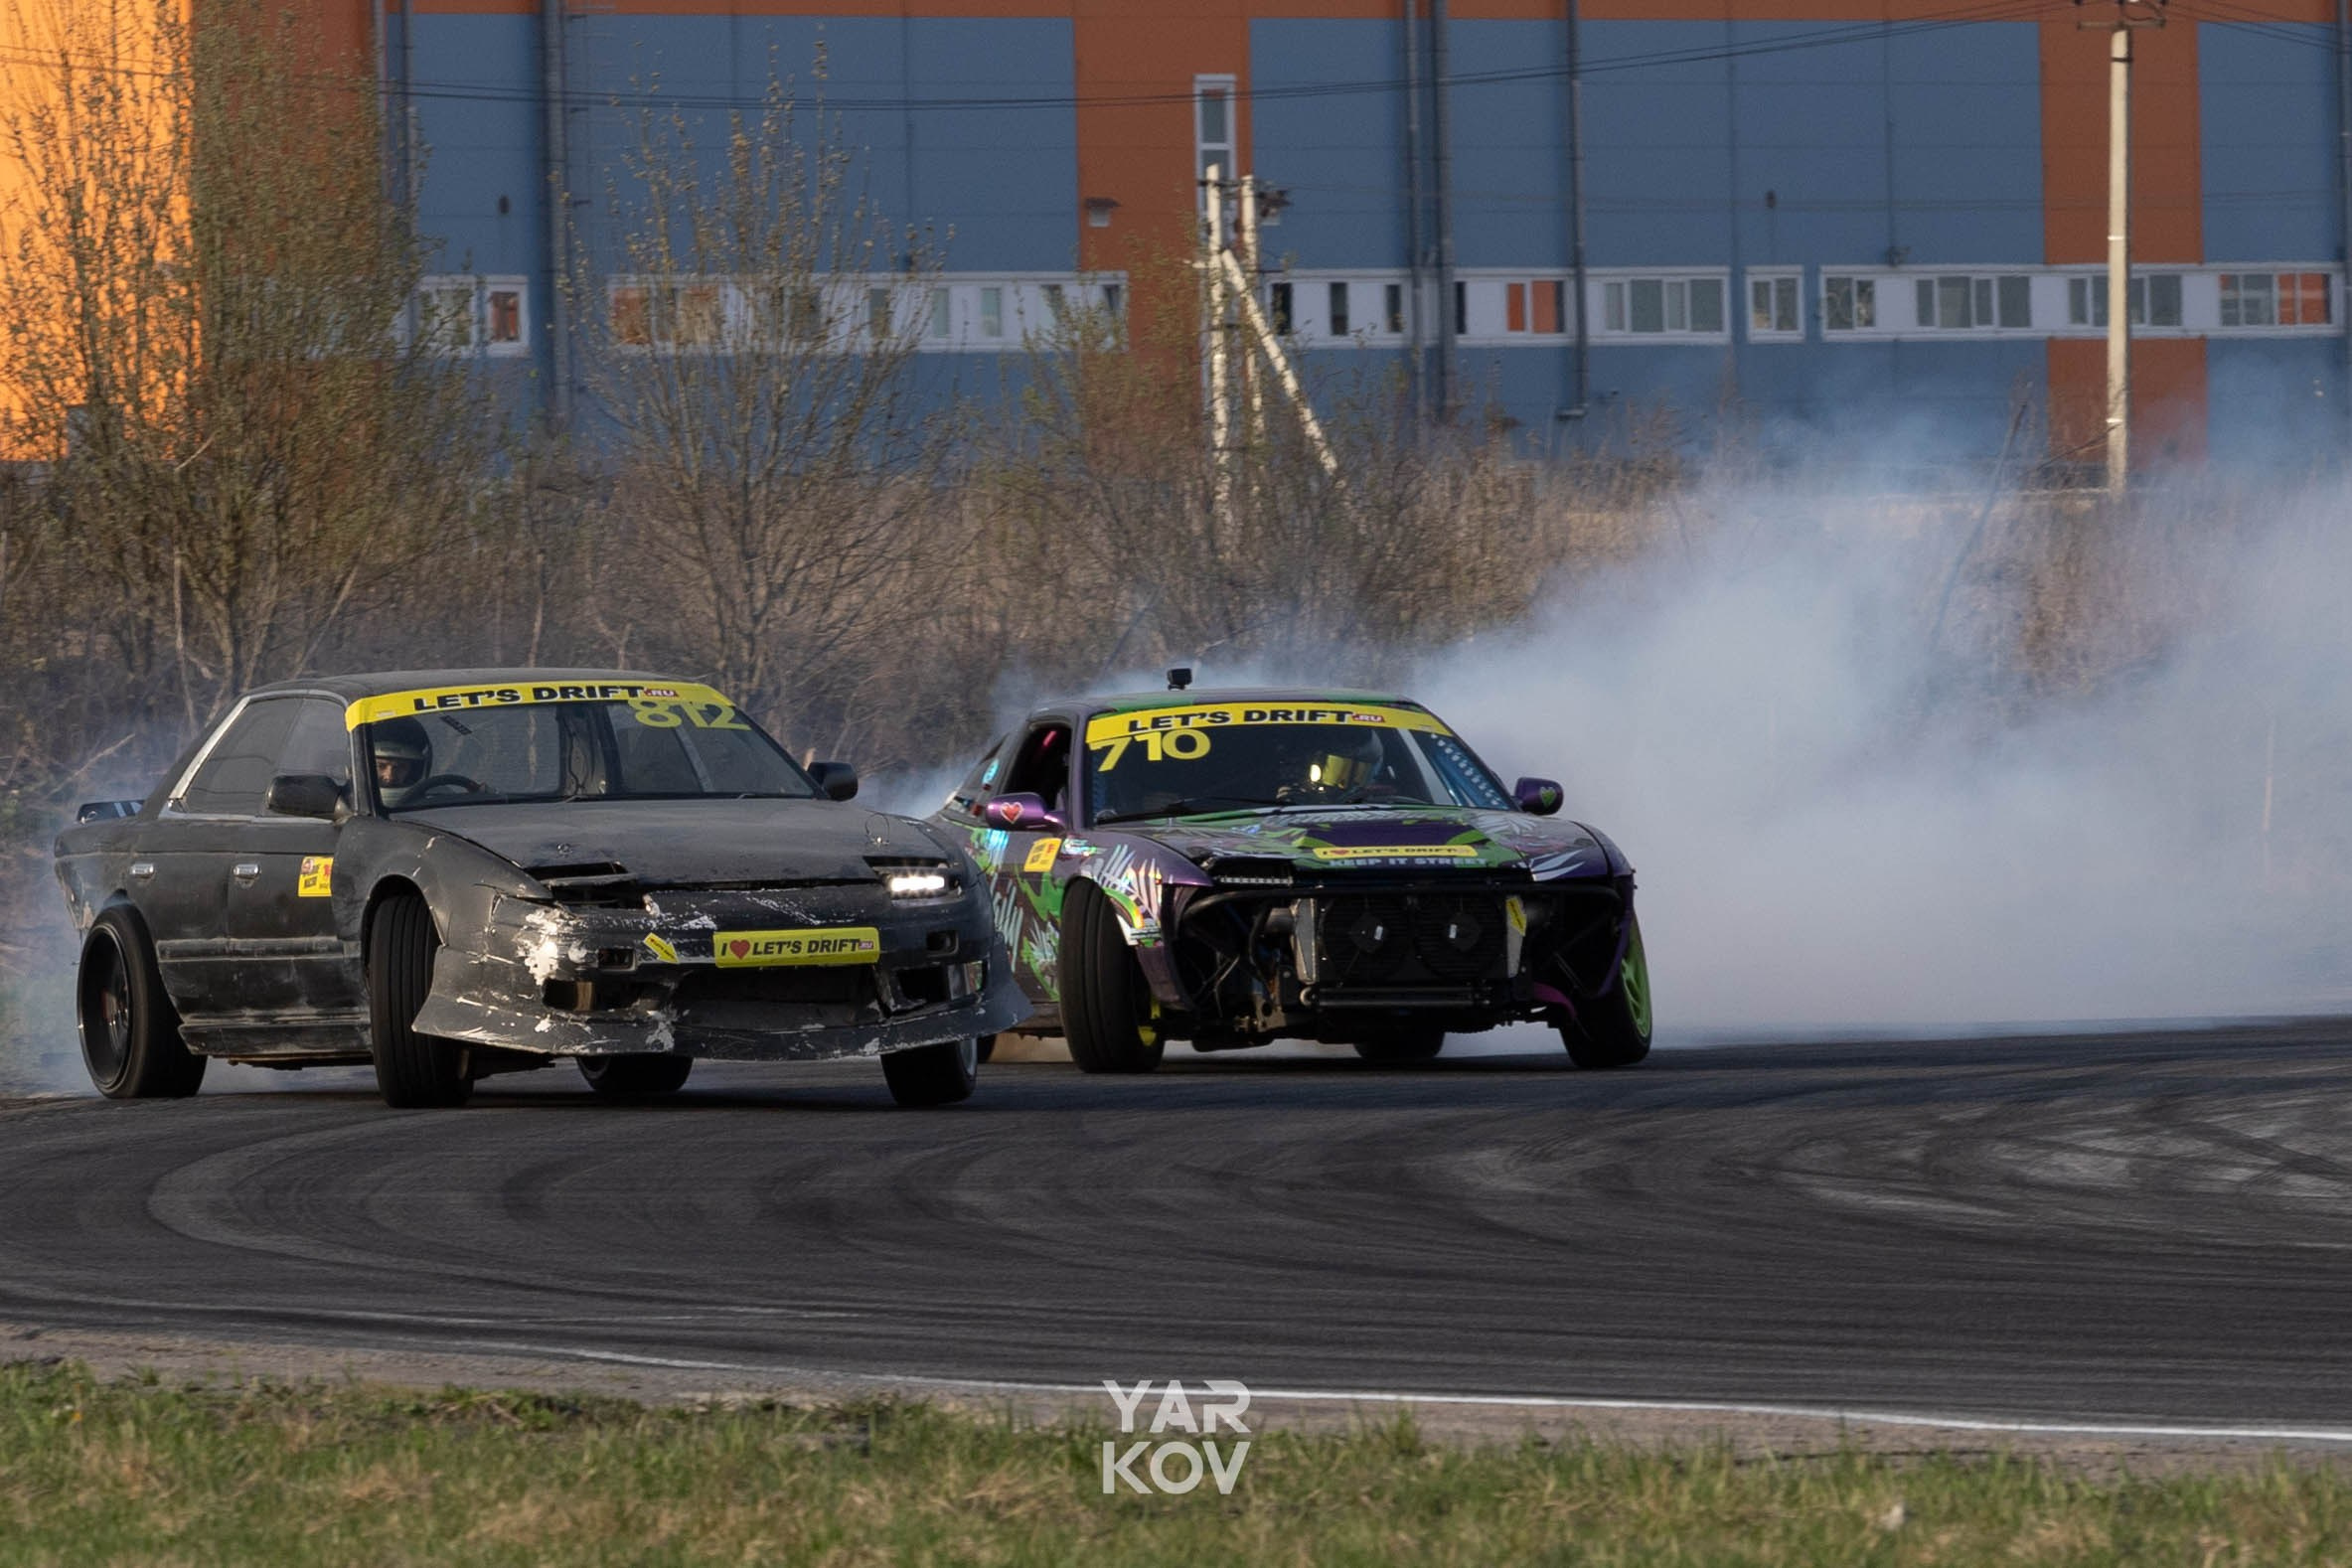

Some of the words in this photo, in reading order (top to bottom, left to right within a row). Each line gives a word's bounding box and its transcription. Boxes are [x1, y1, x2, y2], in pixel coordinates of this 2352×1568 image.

[413, 689, 522, 710] LET'S
[627, 699, 752, 730] 812
[1128, 710, 1231, 732] LET'S
[1088, 728, 1211, 772] 710
[1330, 858, 1382, 866] KEEP
[720, 942, 727, 956] I
[752, 940, 802, 956] LET'S
